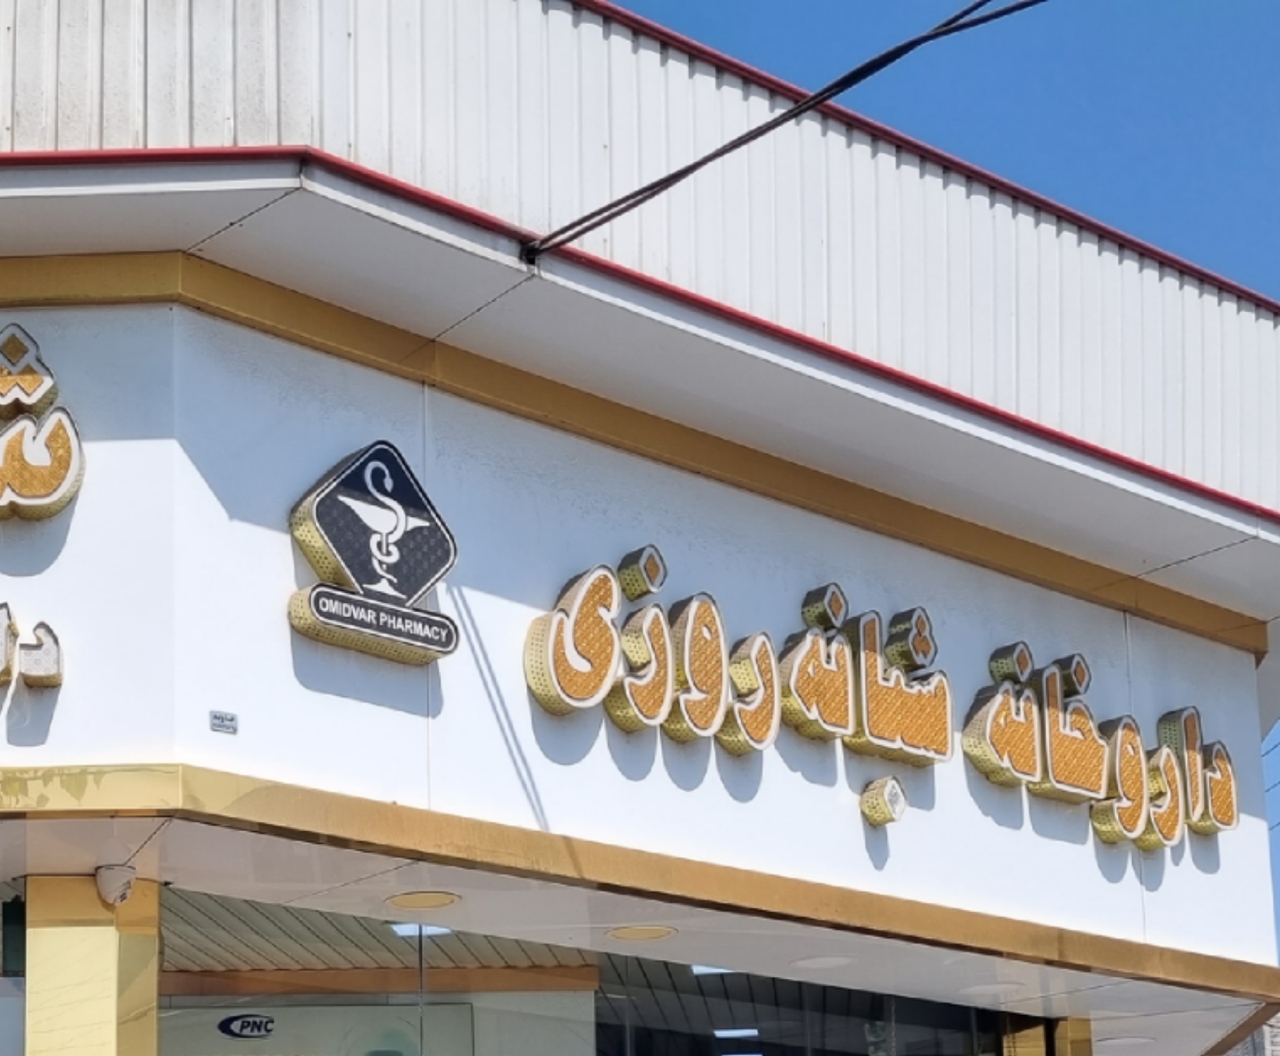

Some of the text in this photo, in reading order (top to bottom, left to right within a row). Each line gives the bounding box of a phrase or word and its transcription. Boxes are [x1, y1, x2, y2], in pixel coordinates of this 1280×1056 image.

[319, 597, 448, 642] OMIDVAR PHARMACY
[524, 544, 1239, 851] داروخانه شبانه روزی
